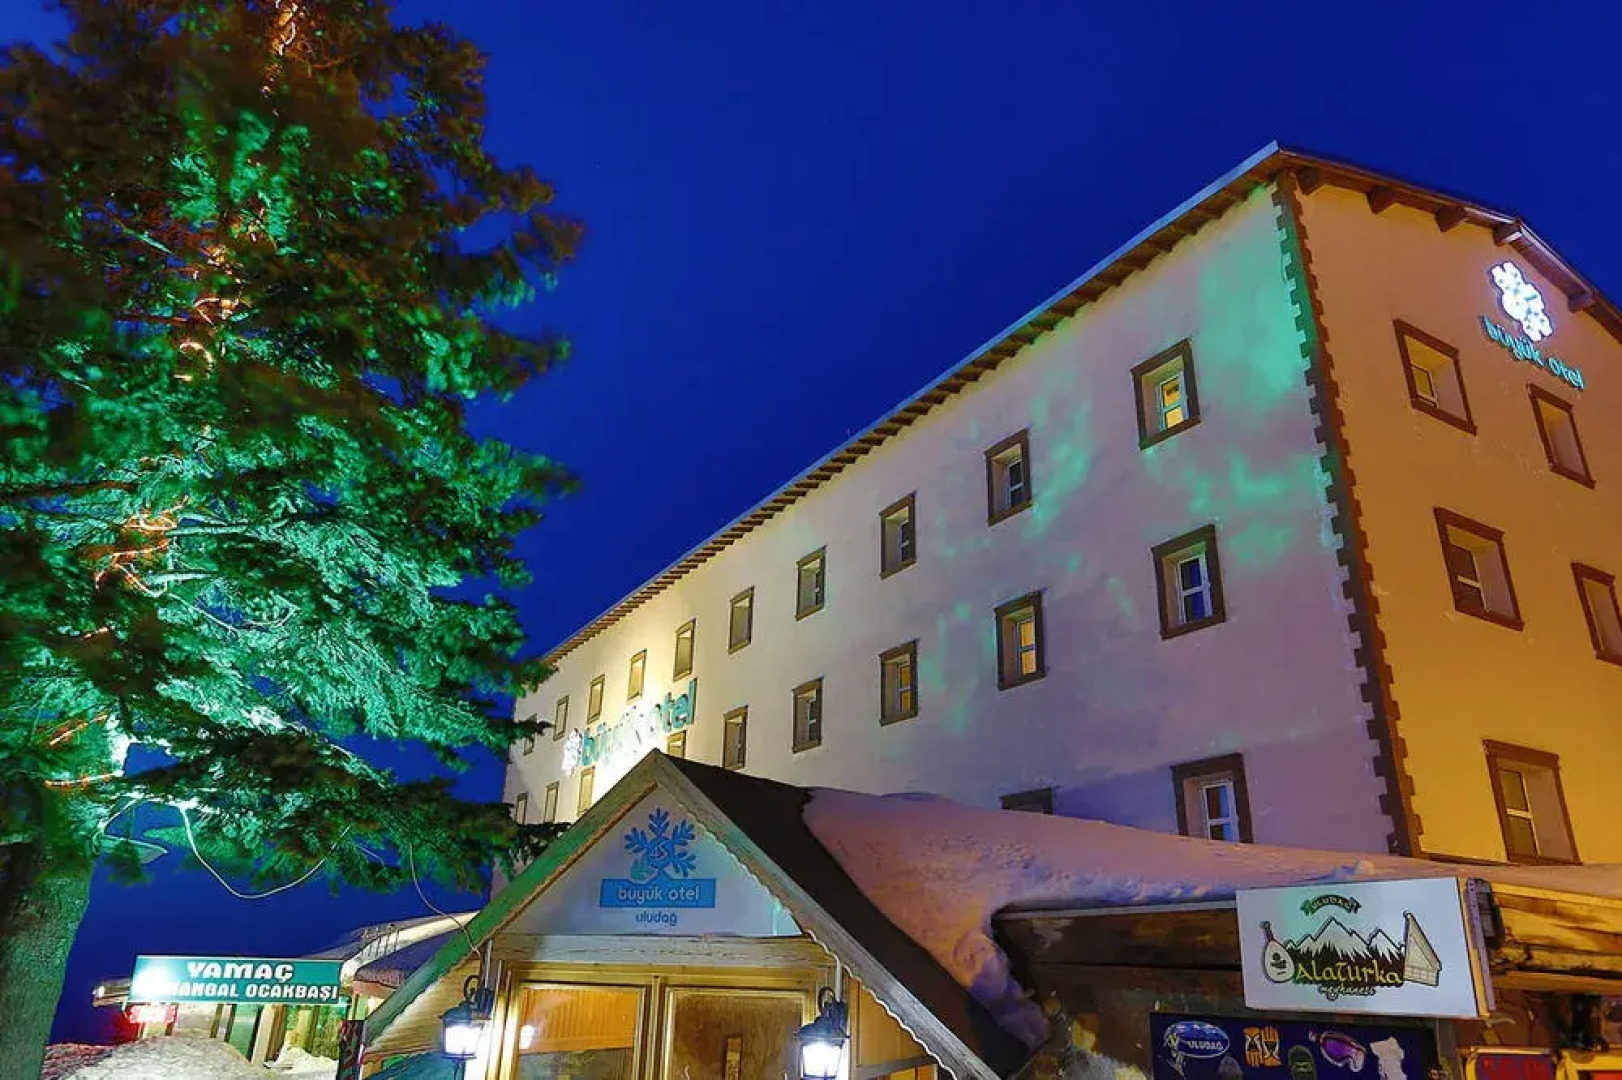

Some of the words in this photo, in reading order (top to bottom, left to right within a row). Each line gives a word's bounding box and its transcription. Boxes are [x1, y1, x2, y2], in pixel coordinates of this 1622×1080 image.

[1548, 357, 1585, 390] otel
[618, 885, 662, 904] büyük
[668, 885, 700, 901] otel
[187, 961, 293, 982] YAMAÇ
[166, 982, 239, 998] ANGAL
[245, 983, 338, 1001] OCAKBAŞI
